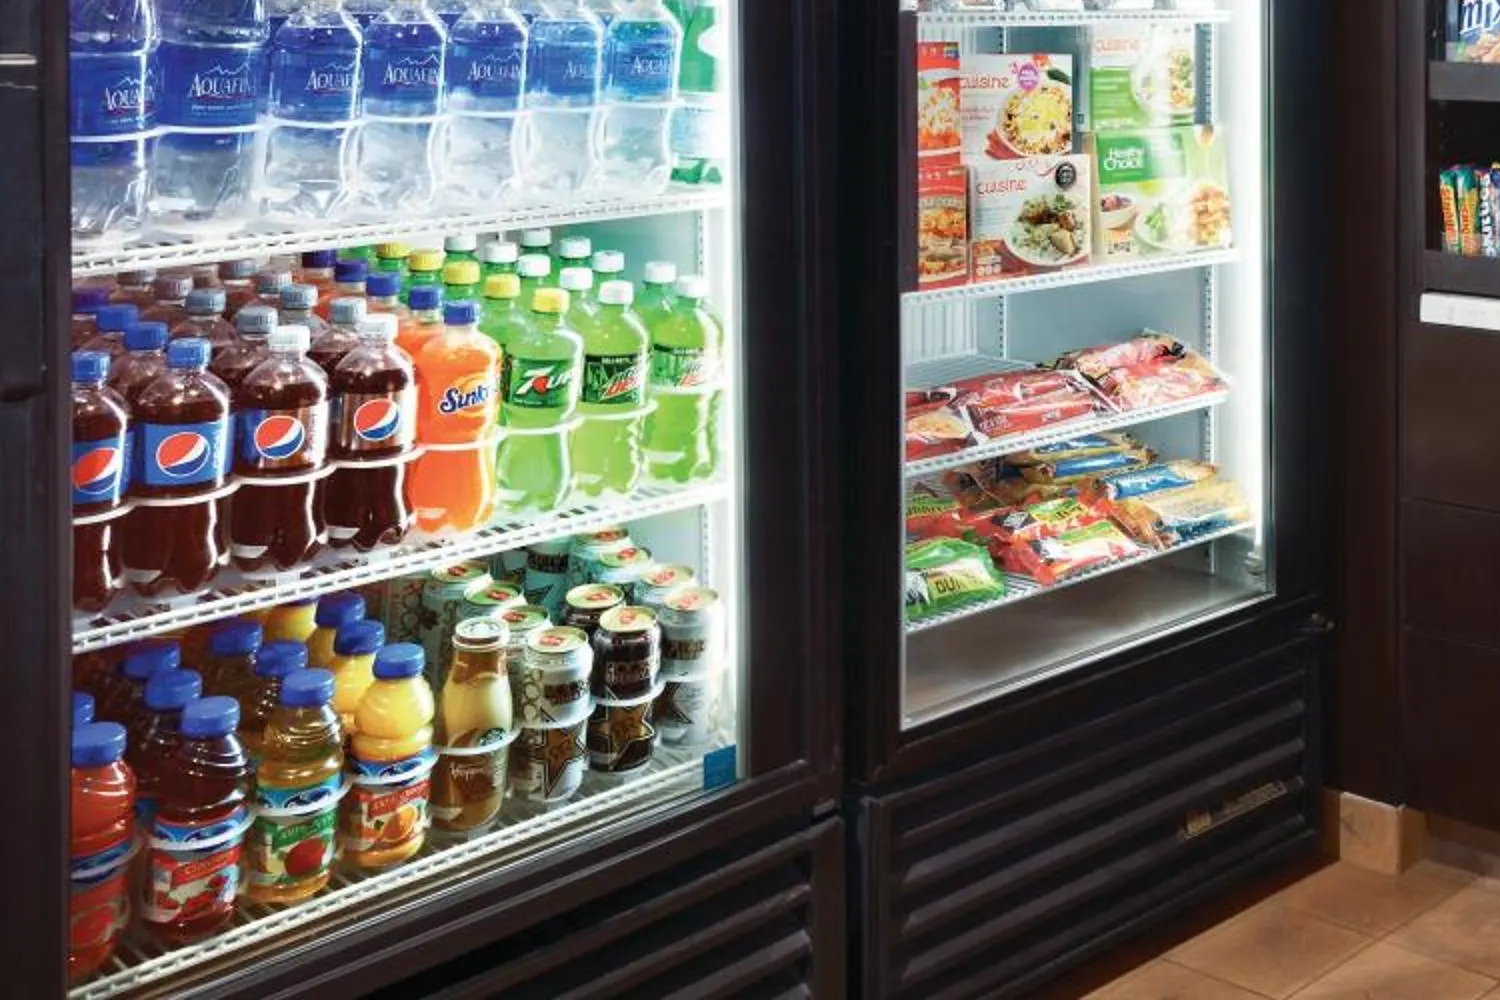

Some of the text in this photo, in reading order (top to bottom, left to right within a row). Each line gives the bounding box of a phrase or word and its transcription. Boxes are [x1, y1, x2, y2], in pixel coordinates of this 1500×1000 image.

[304, 69, 356, 91] AQUAF
[383, 61, 441, 87] AQUAFIN
[959, 73, 1010, 89] cuisine
[976, 177, 1027, 195] cuisine
[438, 385, 490, 414] Sunk
